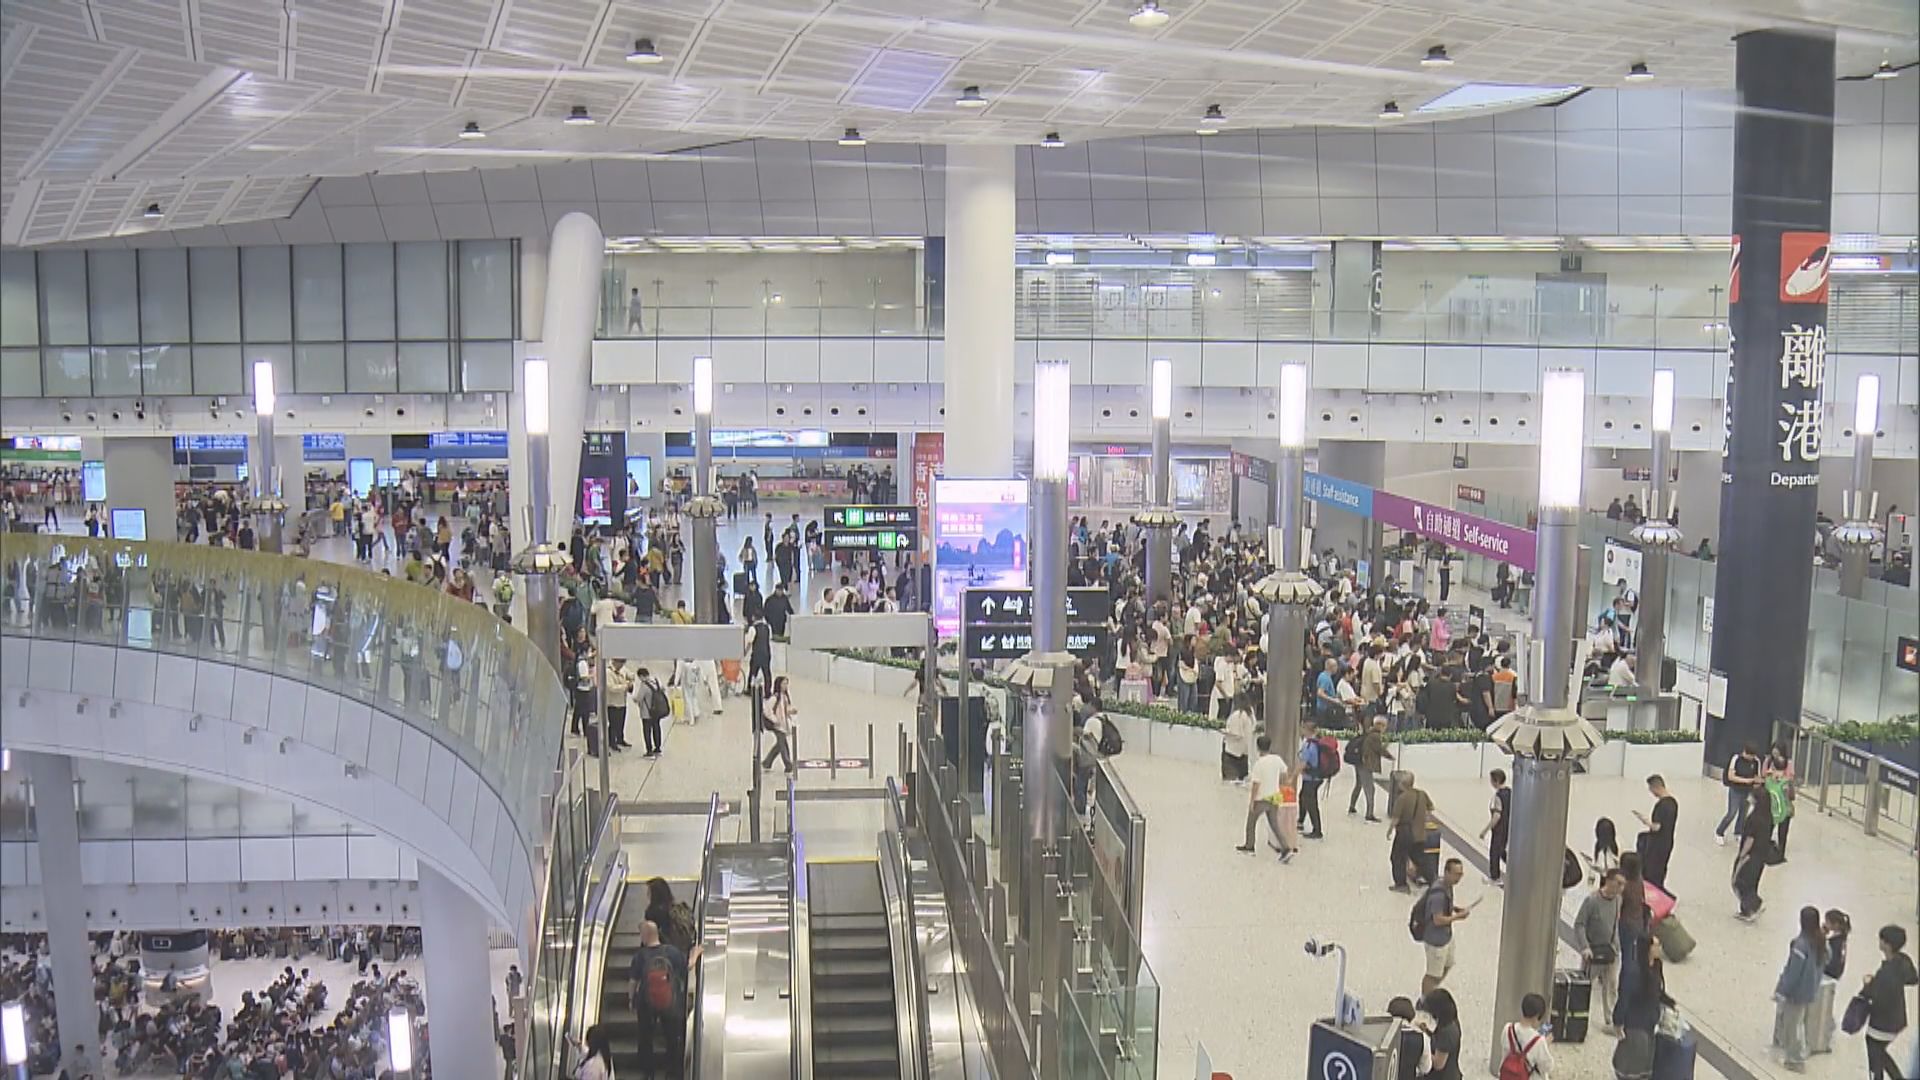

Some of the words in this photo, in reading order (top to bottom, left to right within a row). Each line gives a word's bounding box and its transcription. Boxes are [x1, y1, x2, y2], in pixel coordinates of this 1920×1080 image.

[1779, 324, 1826, 461] 離港
[1771, 472, 1819, 489] Departu
[1334, 488, 1359, 507] assistance
[1464, 524, 1509, 555] Self-service
